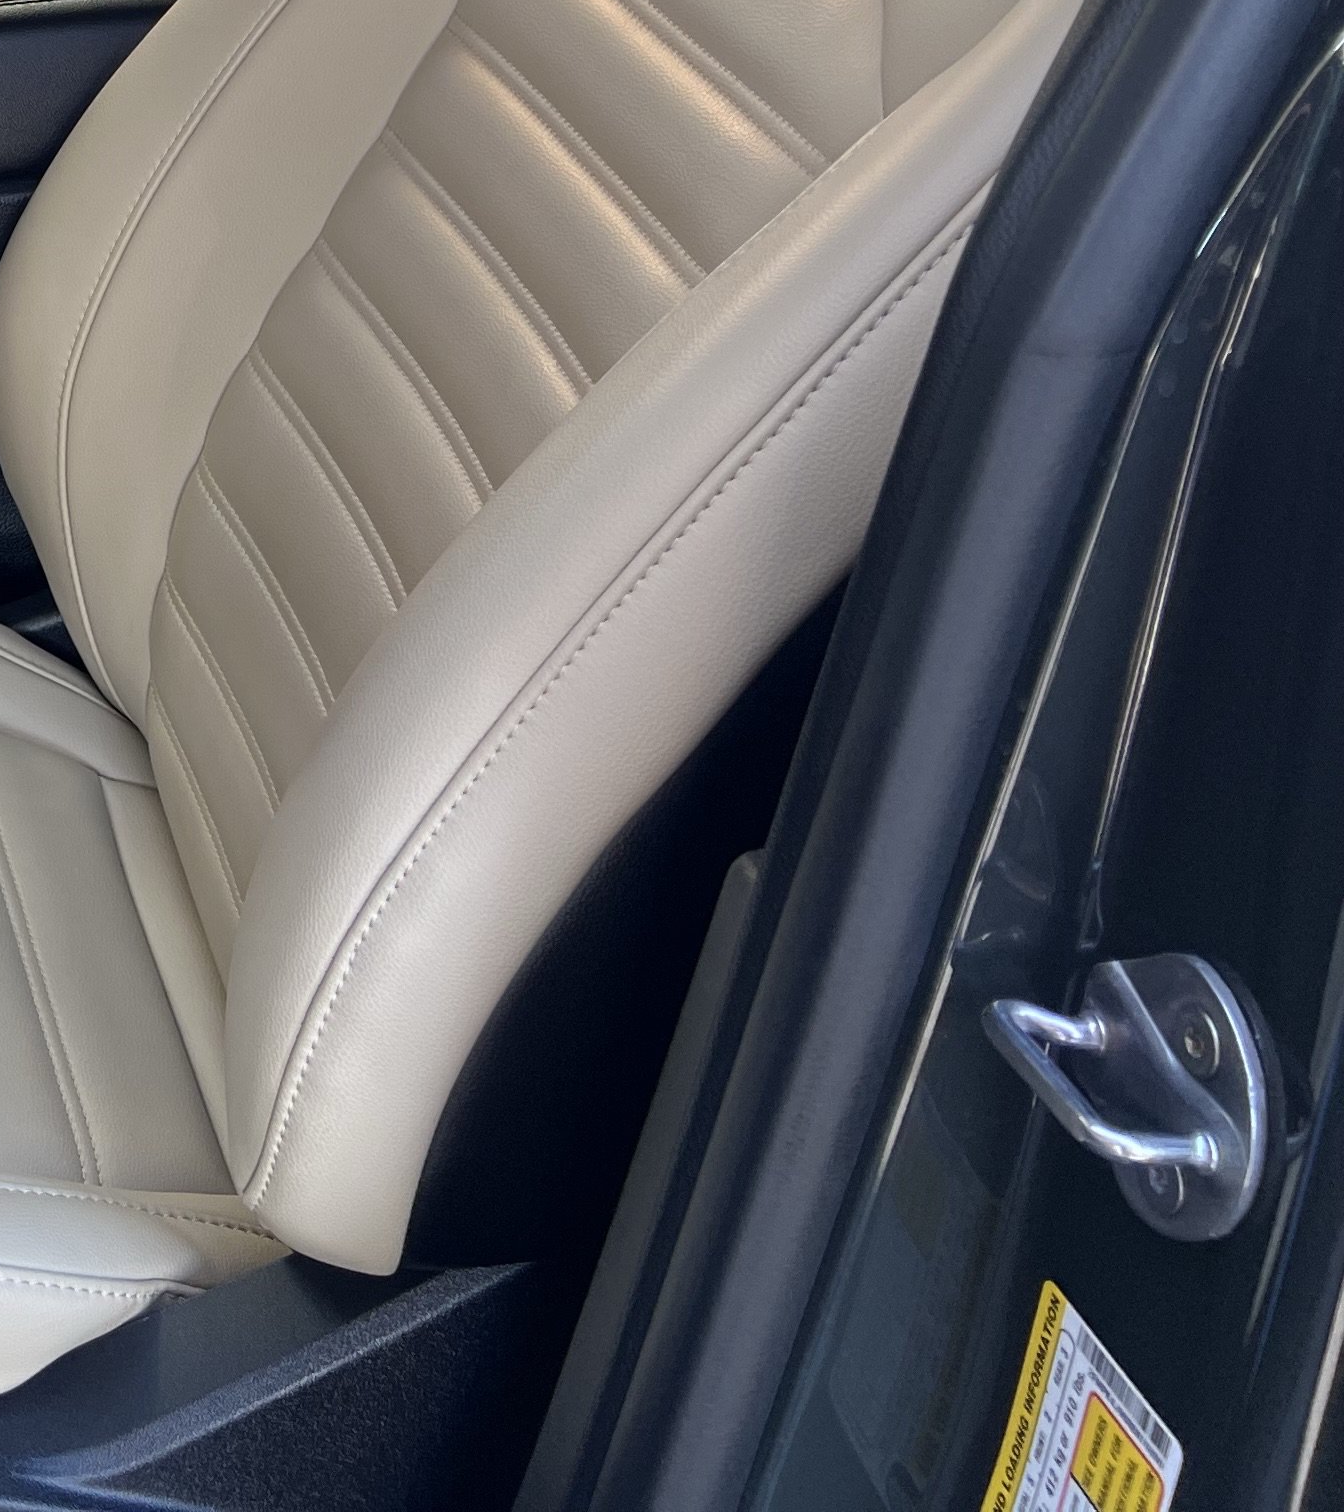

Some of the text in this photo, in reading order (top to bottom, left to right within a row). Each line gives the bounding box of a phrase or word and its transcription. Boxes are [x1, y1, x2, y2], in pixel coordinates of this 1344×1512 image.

[1001, 1416, 1030, 1493] LOADING
[1023, 1292, 1062, 1416] INFORMATION
[1045, 1468, 1060, 1497] 412
[1064, 1397, 1078, 1427] 910
